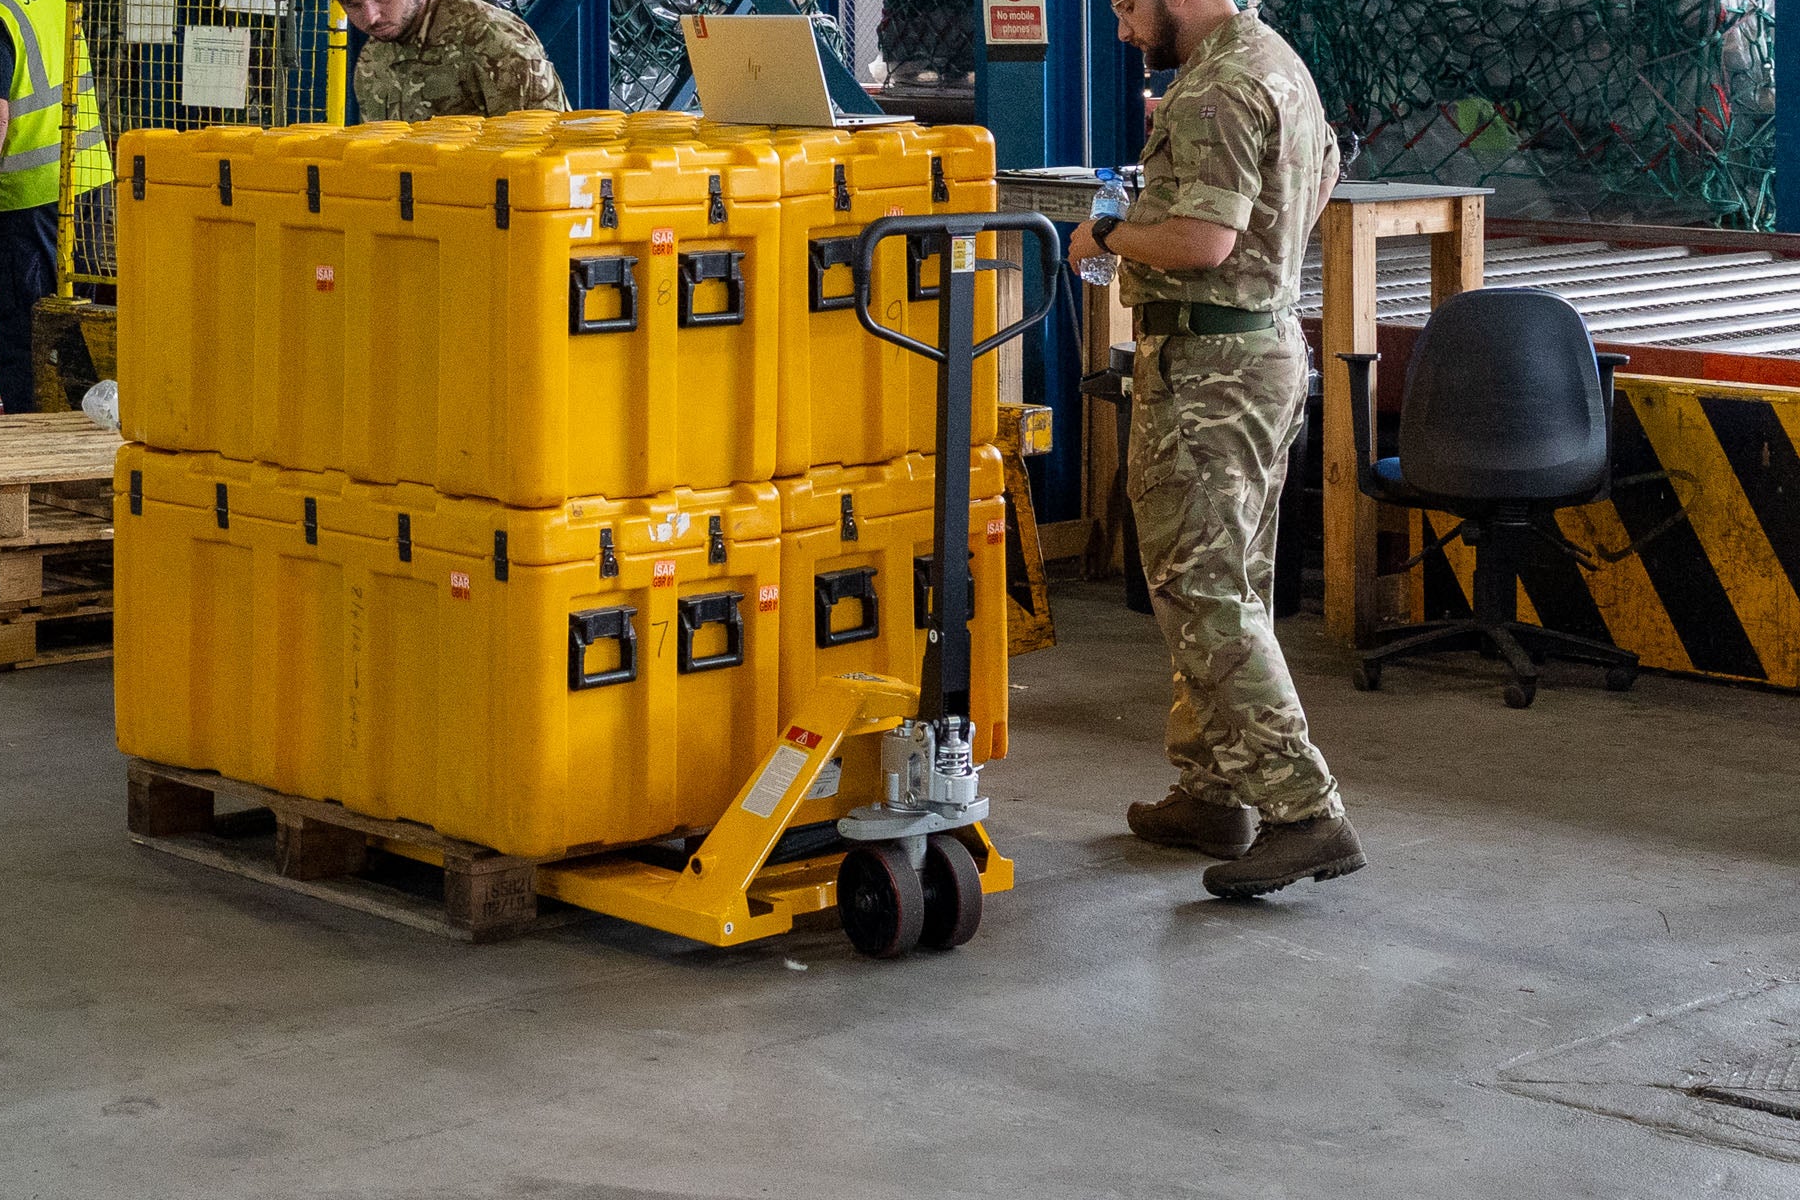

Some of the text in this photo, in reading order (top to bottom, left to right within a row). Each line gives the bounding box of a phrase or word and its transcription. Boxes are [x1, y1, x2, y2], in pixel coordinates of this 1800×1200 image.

[996, 10, 1035, 20] No mobile
[1002, 25, 1031, 35] phones
[651, 231, 674, 244] ISAR
[651, 243, 666, 255] GBR
[315, 267, 334, 281] ISAR
[657, 278, 672, 306] 8
[886, 299, 903, 362] 9
[986, 521, 1005, 535] ISAR
[653, 563, 676, 576] ISAR
[450, 573, 470, 589] ISAR
[652, 576, 666, 588] GBR
[759, 588, 778, 602] ISAR
[759, 601, 772, 612] GBR
[651, 620, 669, 658] 7
[726, 923, 732, 933] 3
